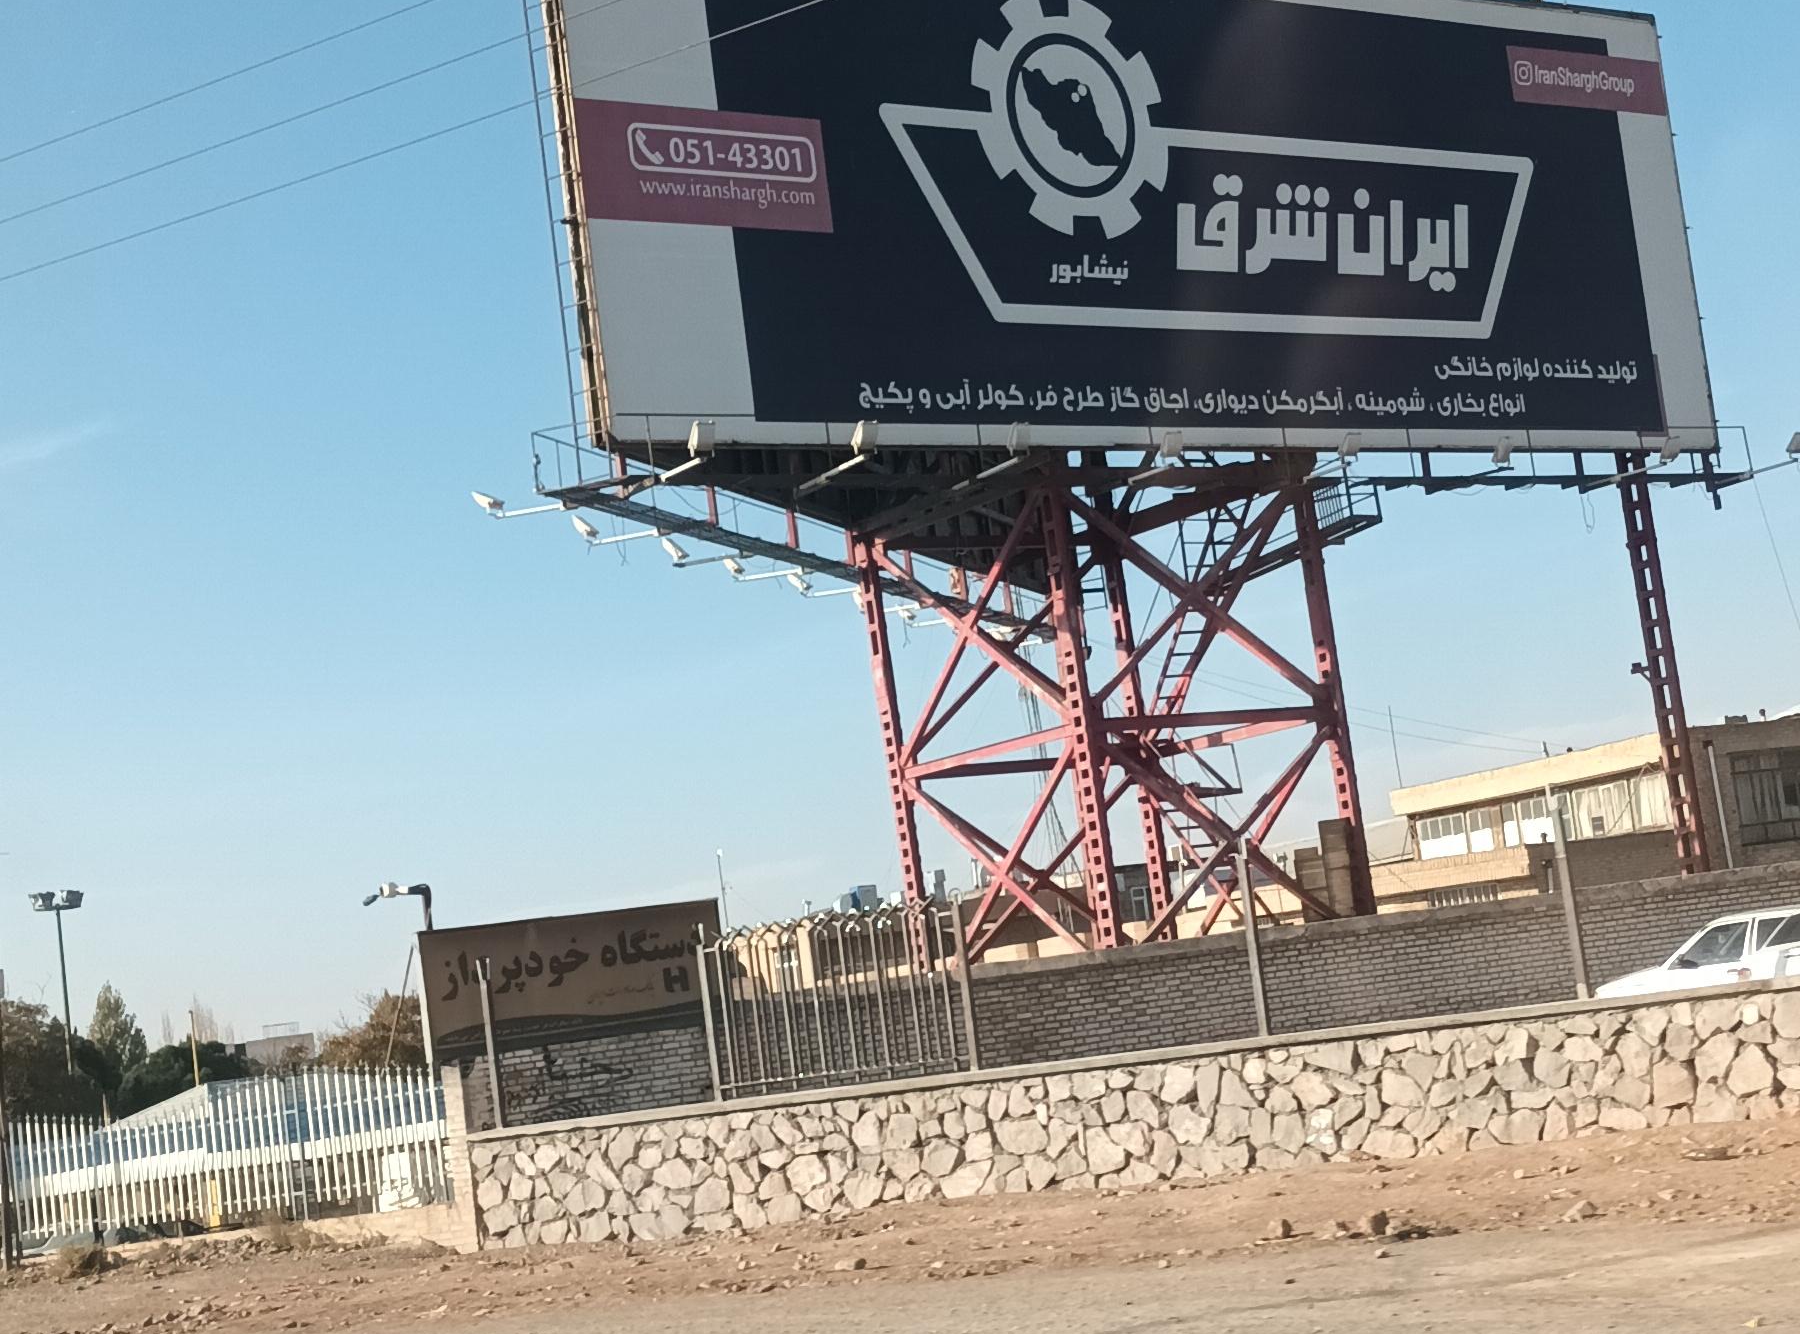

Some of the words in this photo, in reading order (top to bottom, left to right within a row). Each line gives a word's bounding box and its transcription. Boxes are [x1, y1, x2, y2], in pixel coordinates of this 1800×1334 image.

[1534, 64, 1635, 97] IranSharghGroup
[669, 137, 802, 172] 051-43301
[639, 180, 816, 209] www.iranshargh.com
[1176, 173, 1329, 275] شرق
[1337, 187, 1470, 293] ایران
[1049, 253, 1130, 285] نیشابور
[1434, 355, 1494, 380] خانگی
[1496, 356, 1540, 382] لوازم
[1542, 359, 1594, 380] کننده
[1597, 359, 1638, 384] تولید
[858, 380, 914, 414] پکیج
[918, 388, 932, 409] و
[935, 378, 971, 411] آبی
[977, 383, 1025, 411] کولر
[1062, 385, 1105, 412] طرح
[1110, 385, 1140, 412] گاز
[1143, 387, 1190, 413] اجاق
[1262, 386, 1344, 415] آبگرمکن
[1488, 392, 1526, 417] انواع
